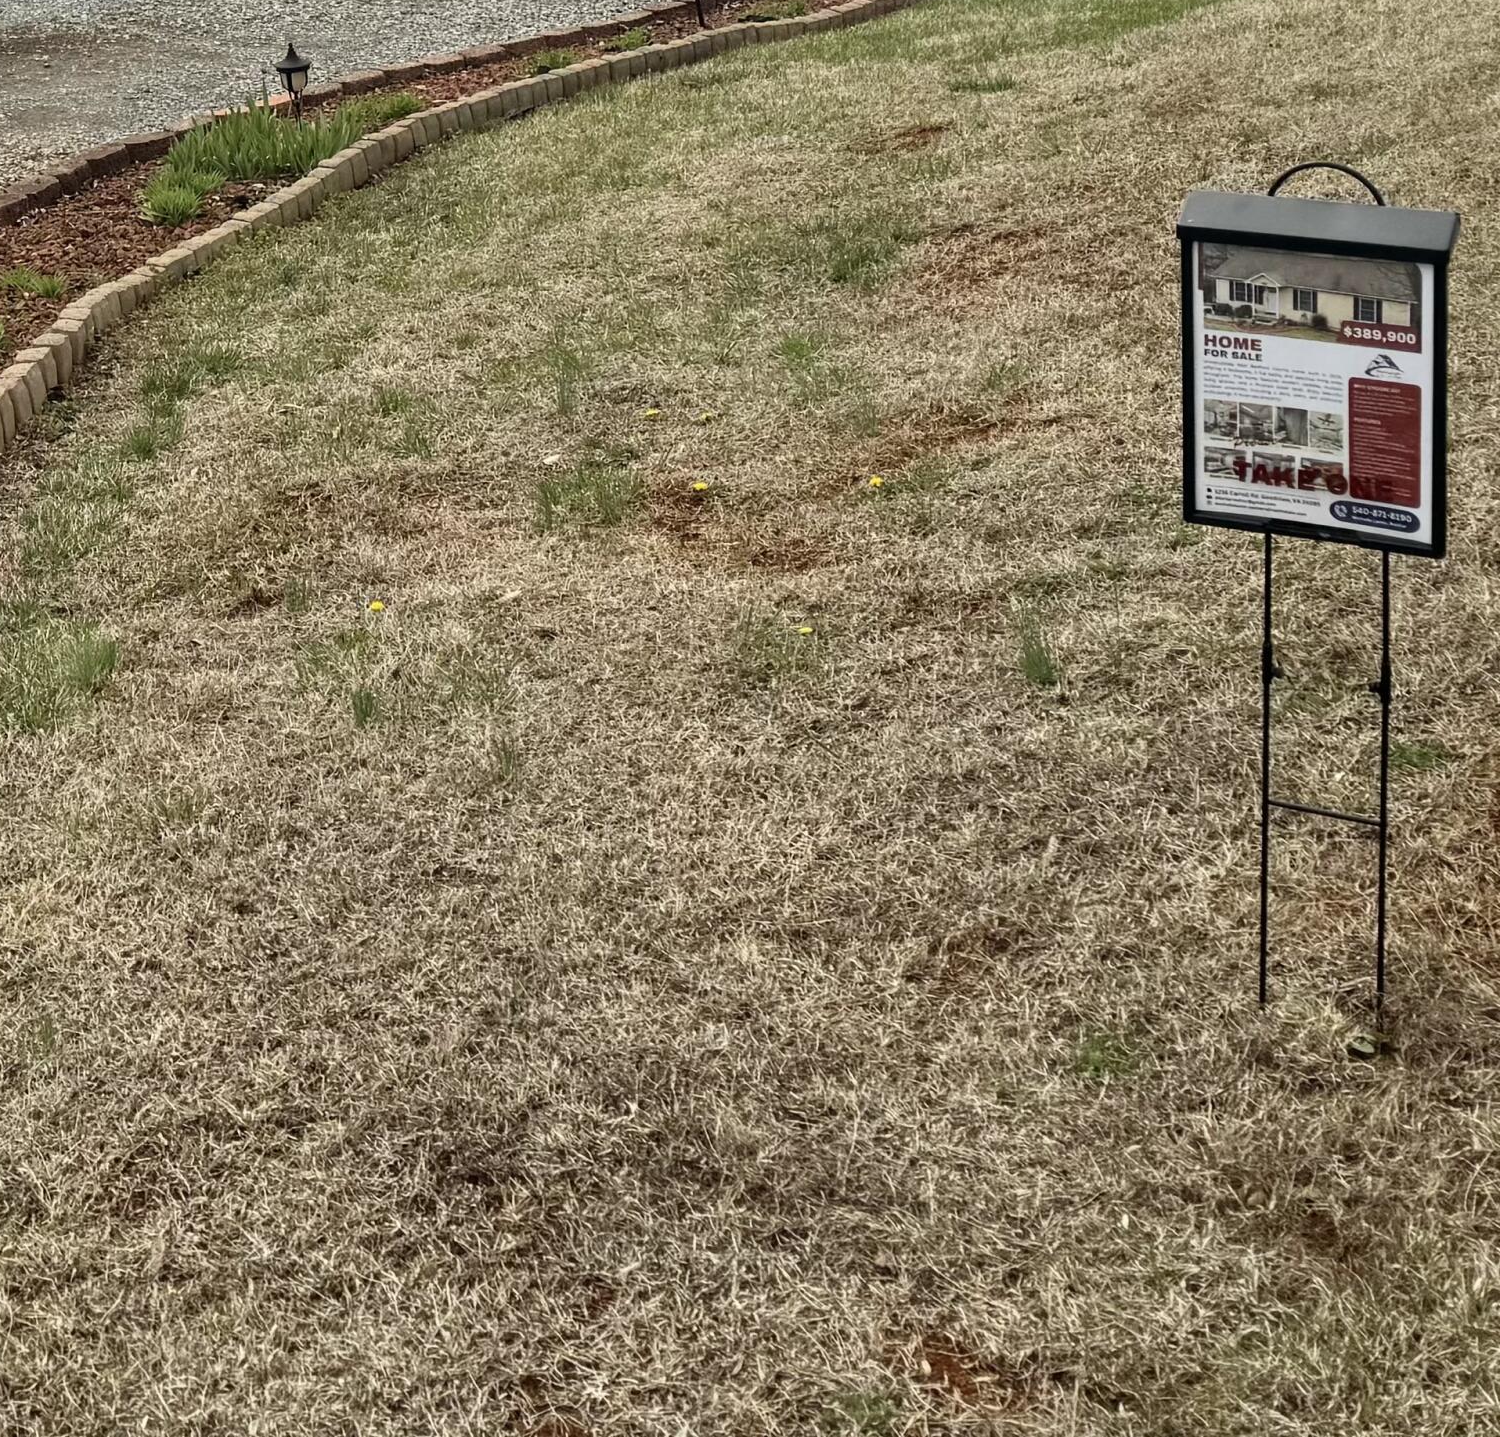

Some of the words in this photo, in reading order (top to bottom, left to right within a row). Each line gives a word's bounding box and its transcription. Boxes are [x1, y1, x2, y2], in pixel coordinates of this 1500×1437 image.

[1204, 334, 1262, 352] HOME
[1343, 325, 1416, 344] $389,900
[1204, 348, 1228, 359] FOR
[1231, 351, 1262, 362] SALE
[1232, 456, 1319, 492] TAKE
